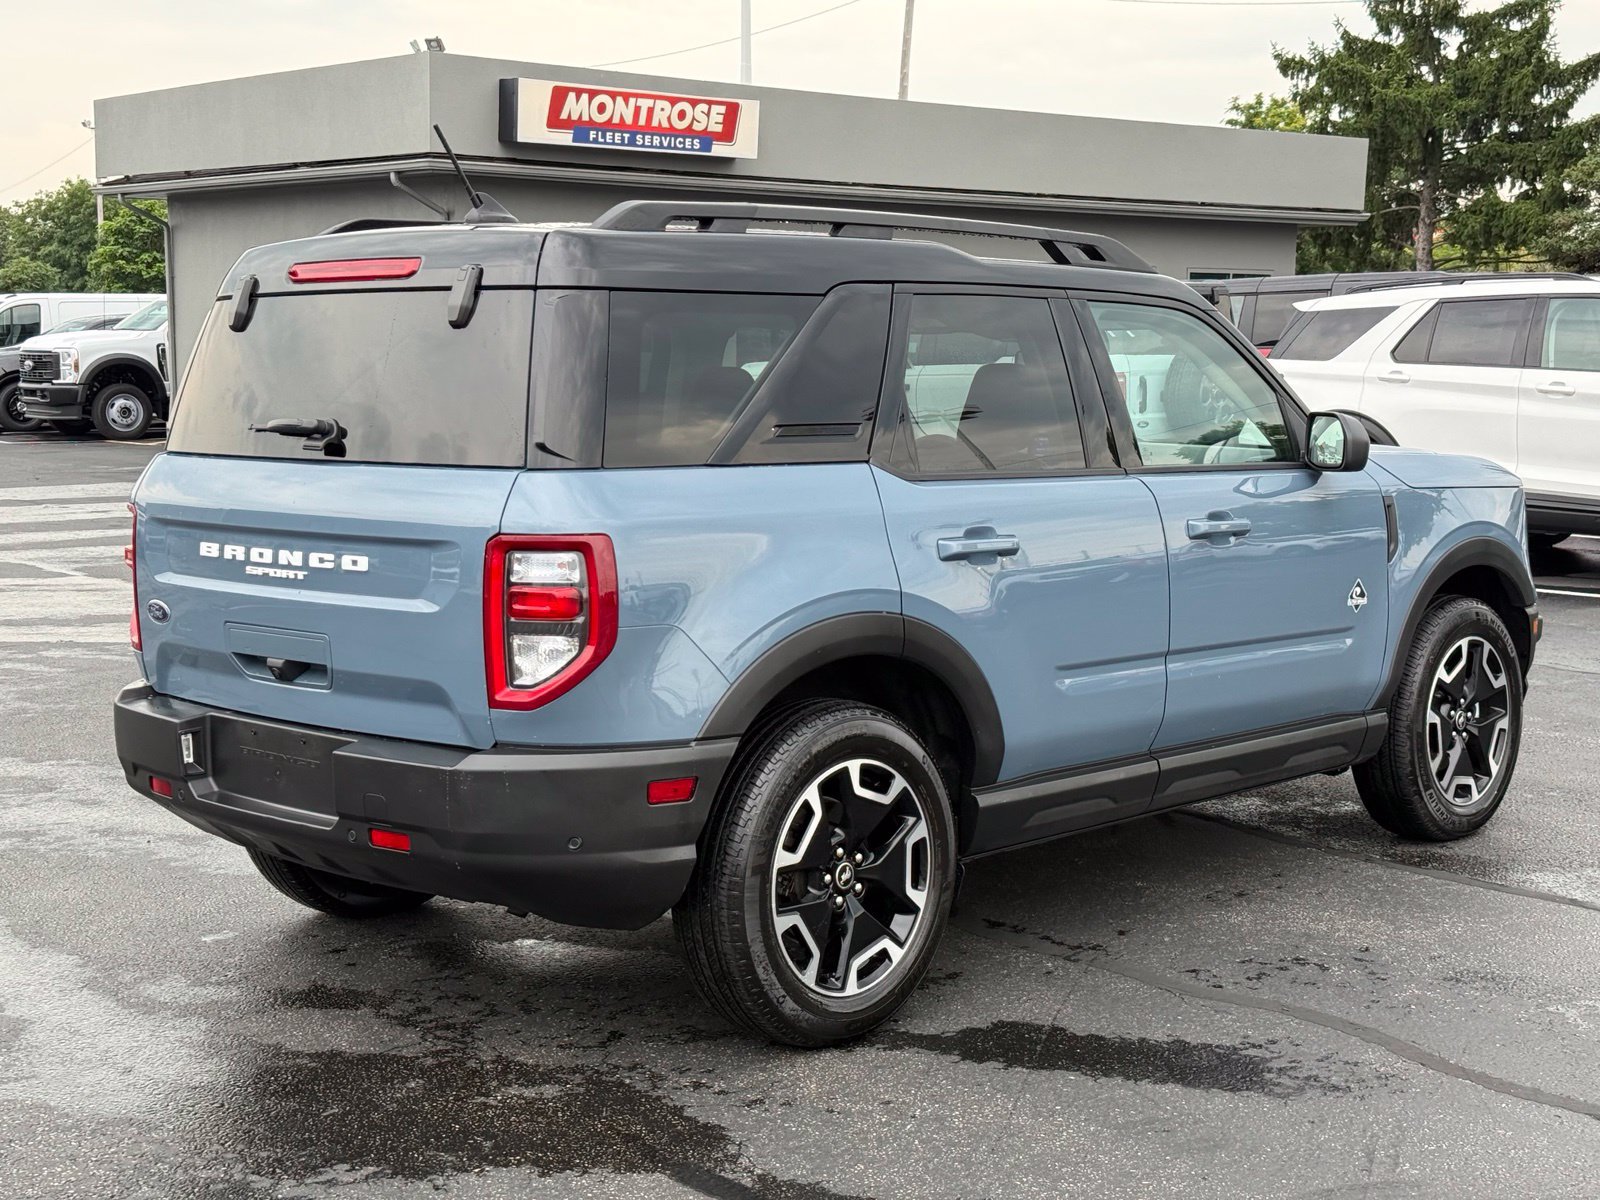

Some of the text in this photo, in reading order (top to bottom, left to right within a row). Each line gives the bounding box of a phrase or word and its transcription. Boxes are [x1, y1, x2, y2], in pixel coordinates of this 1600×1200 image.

[559, 91, 727, 133] MONTROSE
[589, 130, 701, 149] FLEET SERVICES
[199, 541, 369, 572] BRONCO
[245, 565, 309, 580] SPORT
[1489, 616, 1516, 658] MICHELIN
[1427, 791, 1457, 827] MICHELIN
